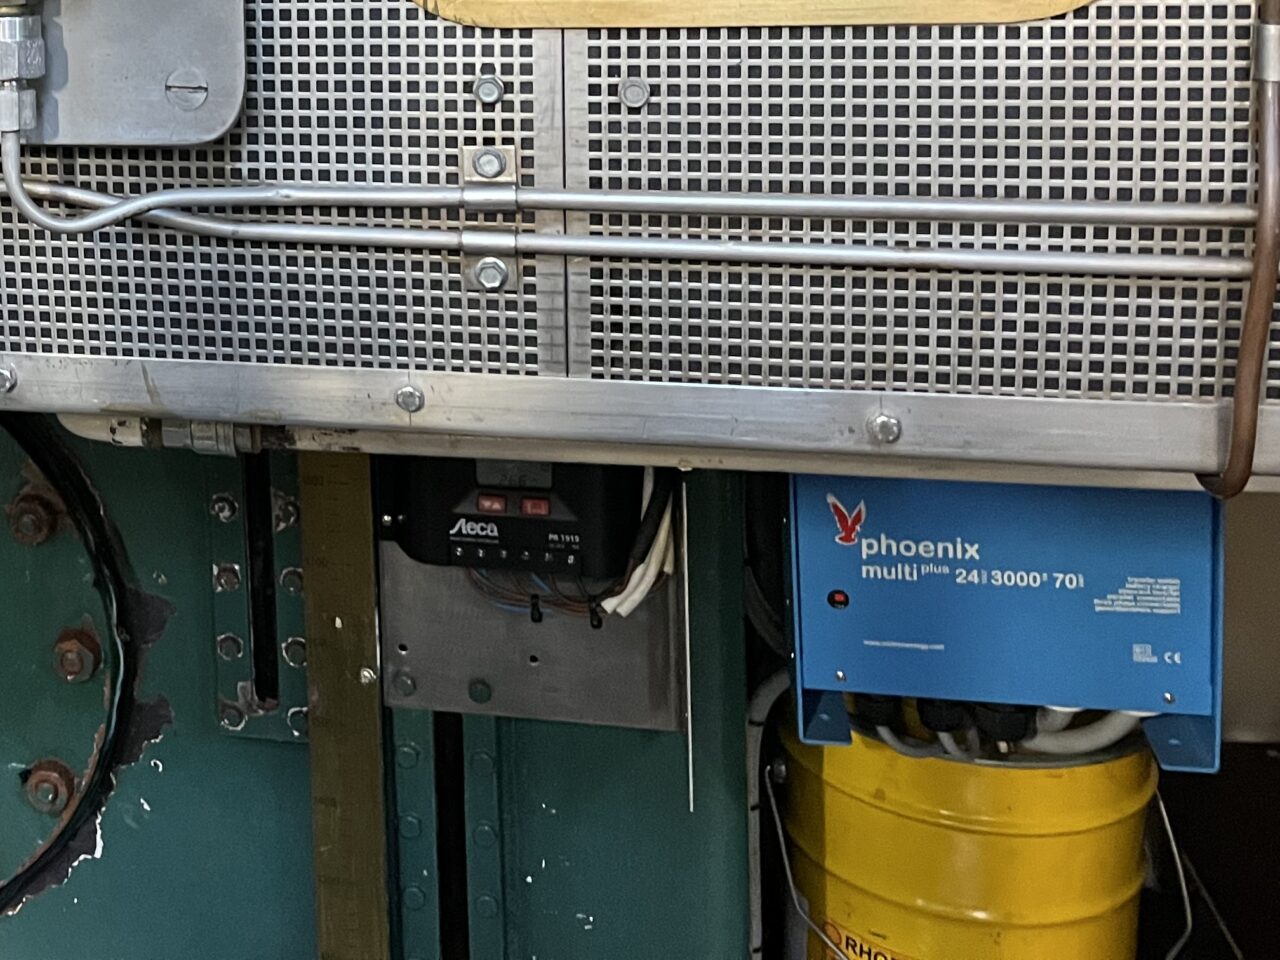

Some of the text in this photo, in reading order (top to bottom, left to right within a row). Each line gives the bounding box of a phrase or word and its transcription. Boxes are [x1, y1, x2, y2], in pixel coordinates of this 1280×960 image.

[861, 532, 980, 560] phoenix
[861, 562, 918, 581] multi
[921, 562, 950, 575] plus
